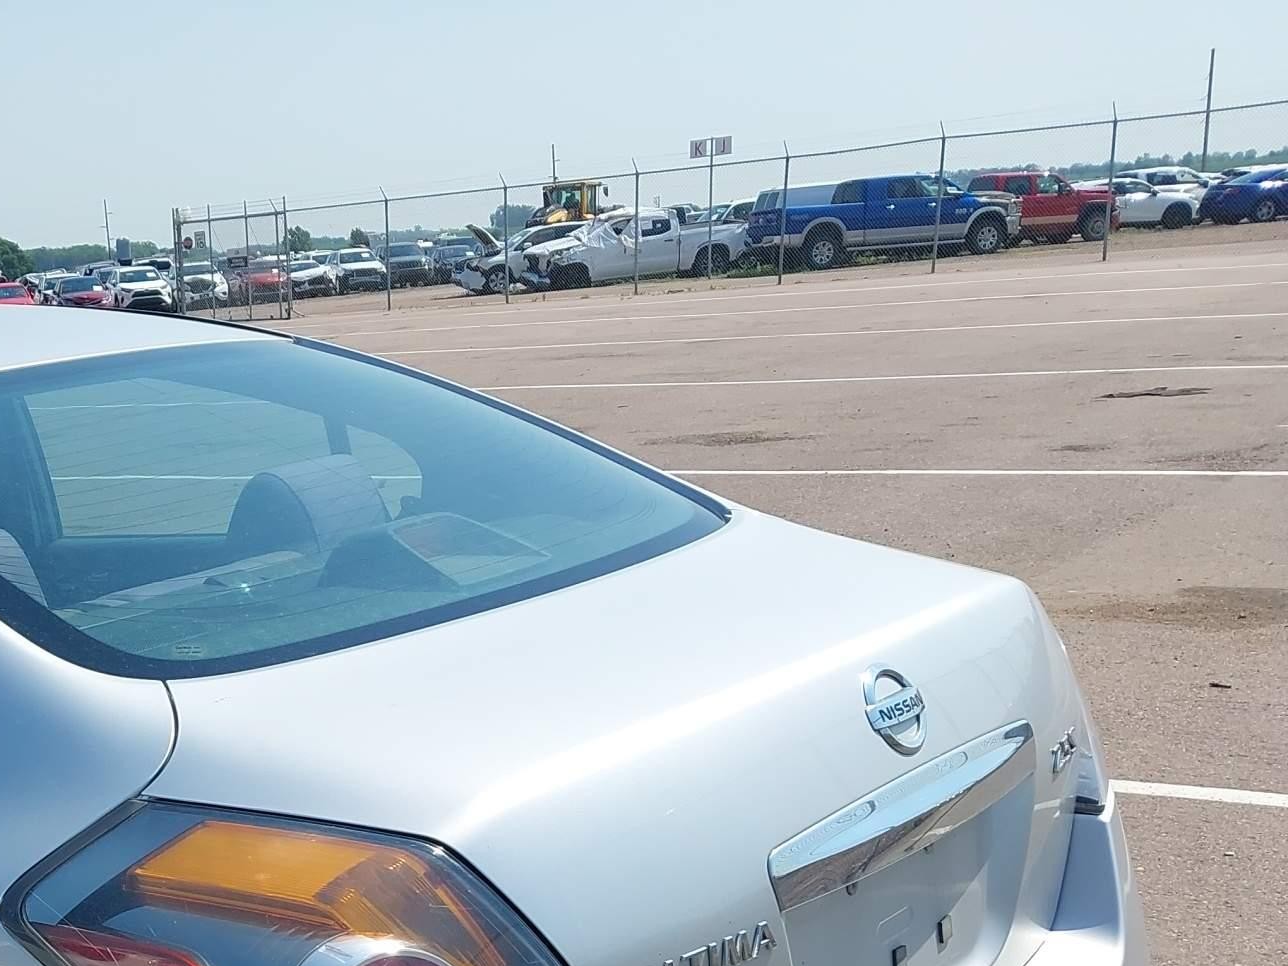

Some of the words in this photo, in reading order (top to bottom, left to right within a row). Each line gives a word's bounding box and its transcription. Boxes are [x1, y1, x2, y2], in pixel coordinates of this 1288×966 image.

[694, 142, 703, 156] K
[720, 137, 726, 153] J
[878, 693, 924, 723] NISSAN
